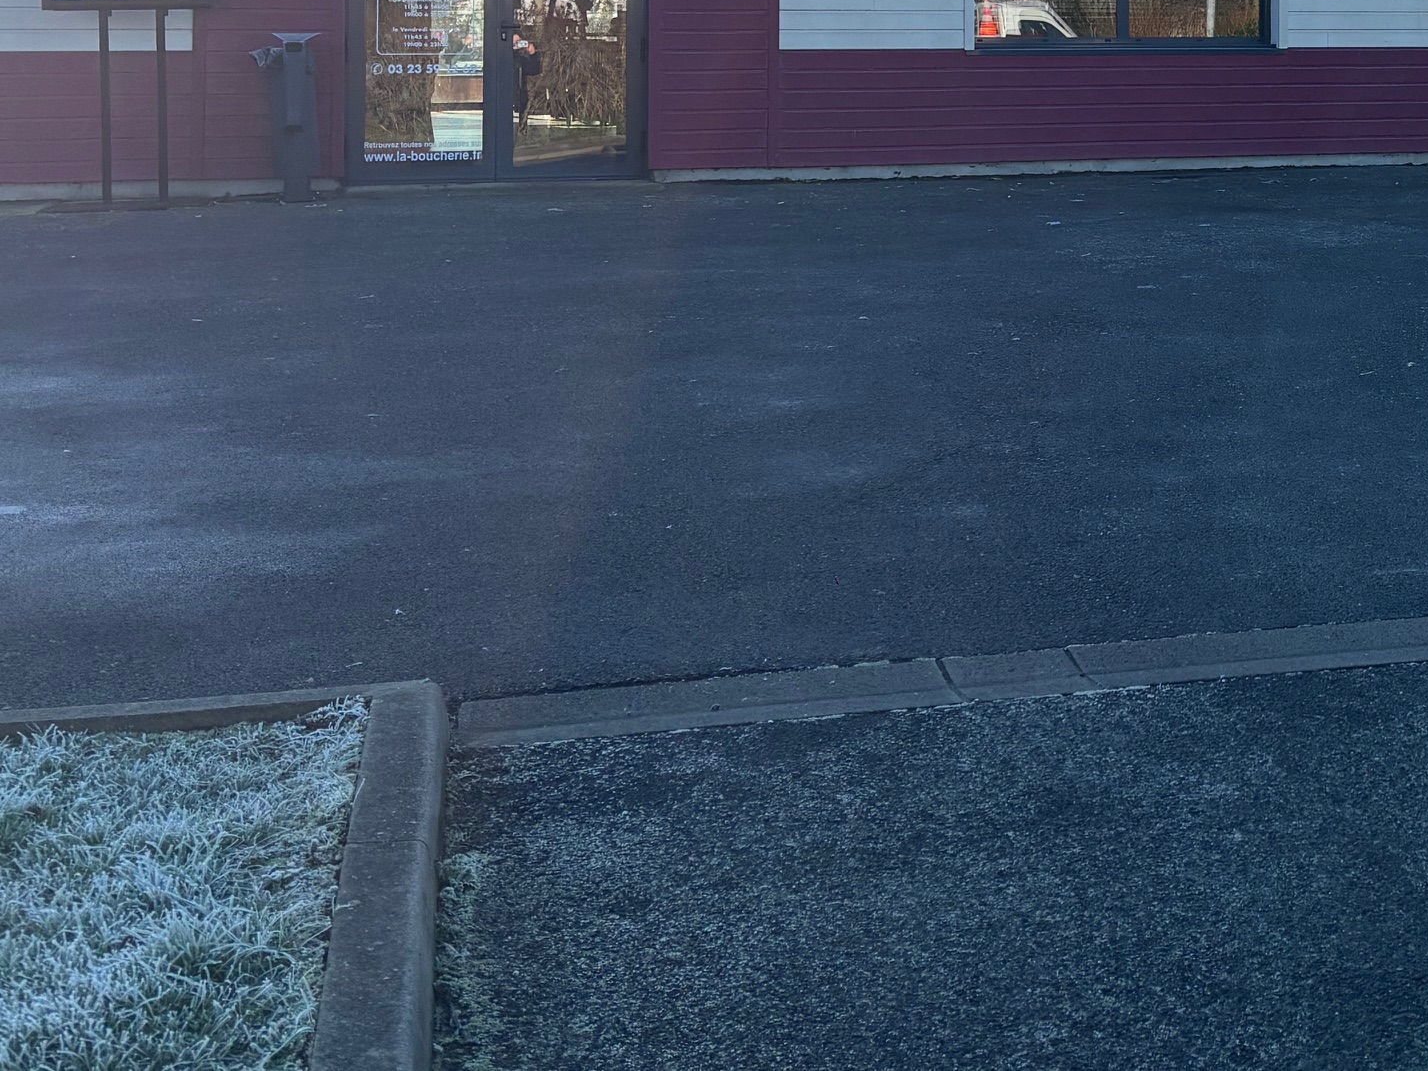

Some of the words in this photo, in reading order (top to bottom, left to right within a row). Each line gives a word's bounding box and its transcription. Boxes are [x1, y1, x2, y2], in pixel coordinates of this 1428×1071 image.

[387, 63, 403, 74] 03
[407, 63, 422, 74] 23
[425, 63, 440, 74] 59
[363, 141, 400, 149] Retrouvez
[400, 141, 423, 149] toutes
[364, 150, 483, 162] www.la-boucherie.fr
